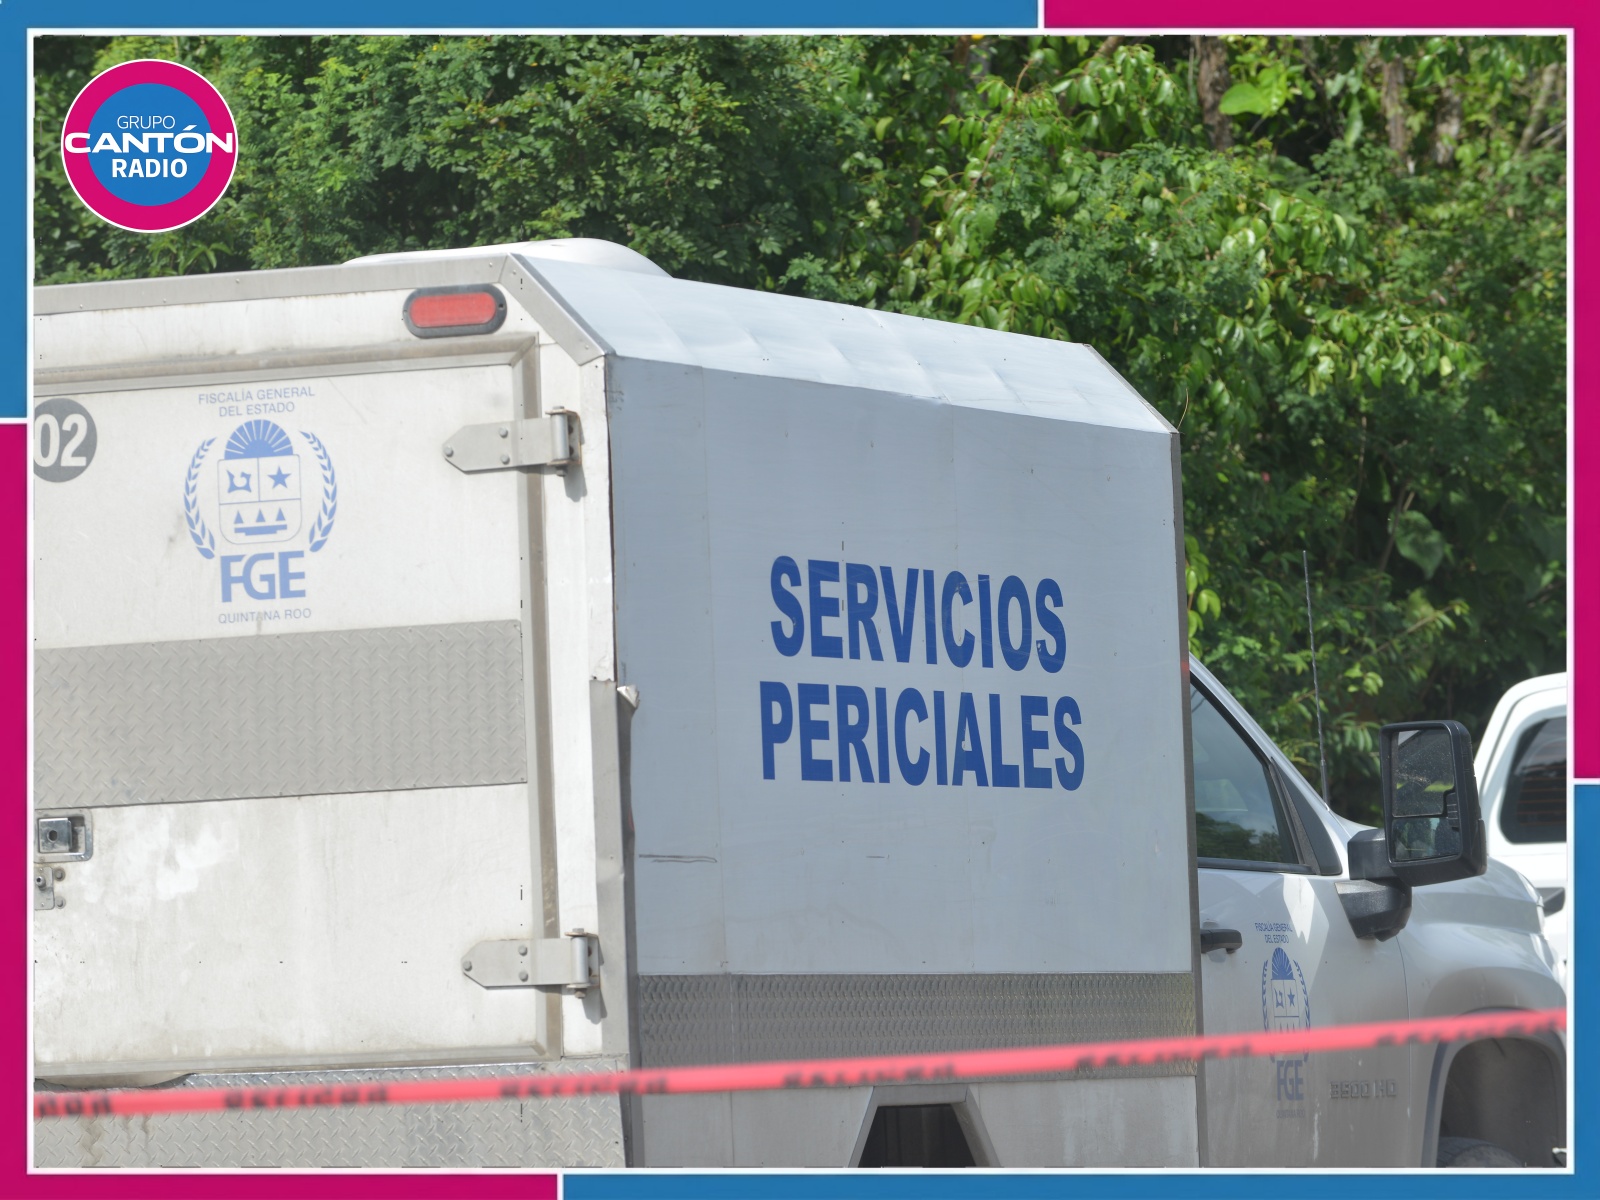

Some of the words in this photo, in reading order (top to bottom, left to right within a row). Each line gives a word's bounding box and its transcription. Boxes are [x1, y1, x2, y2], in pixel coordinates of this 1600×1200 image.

[198, 388, 254, 405] FISCALÍA
[256, 386, 316, 401] GENERAL
[219, 406, 243, 417] DEL
[246, 401, 295, 415] ESTADO
[220, 550, 307, 602] FGE
[218, 610, 281, 624] QUINTANA
[284, 608, 312, 619] ROO
[770, 555, 1067, 674] SERVICIOS
[759, 680, 1086, 792] PERICIALES
[1276, 1059, 1304, 1101] FGE
